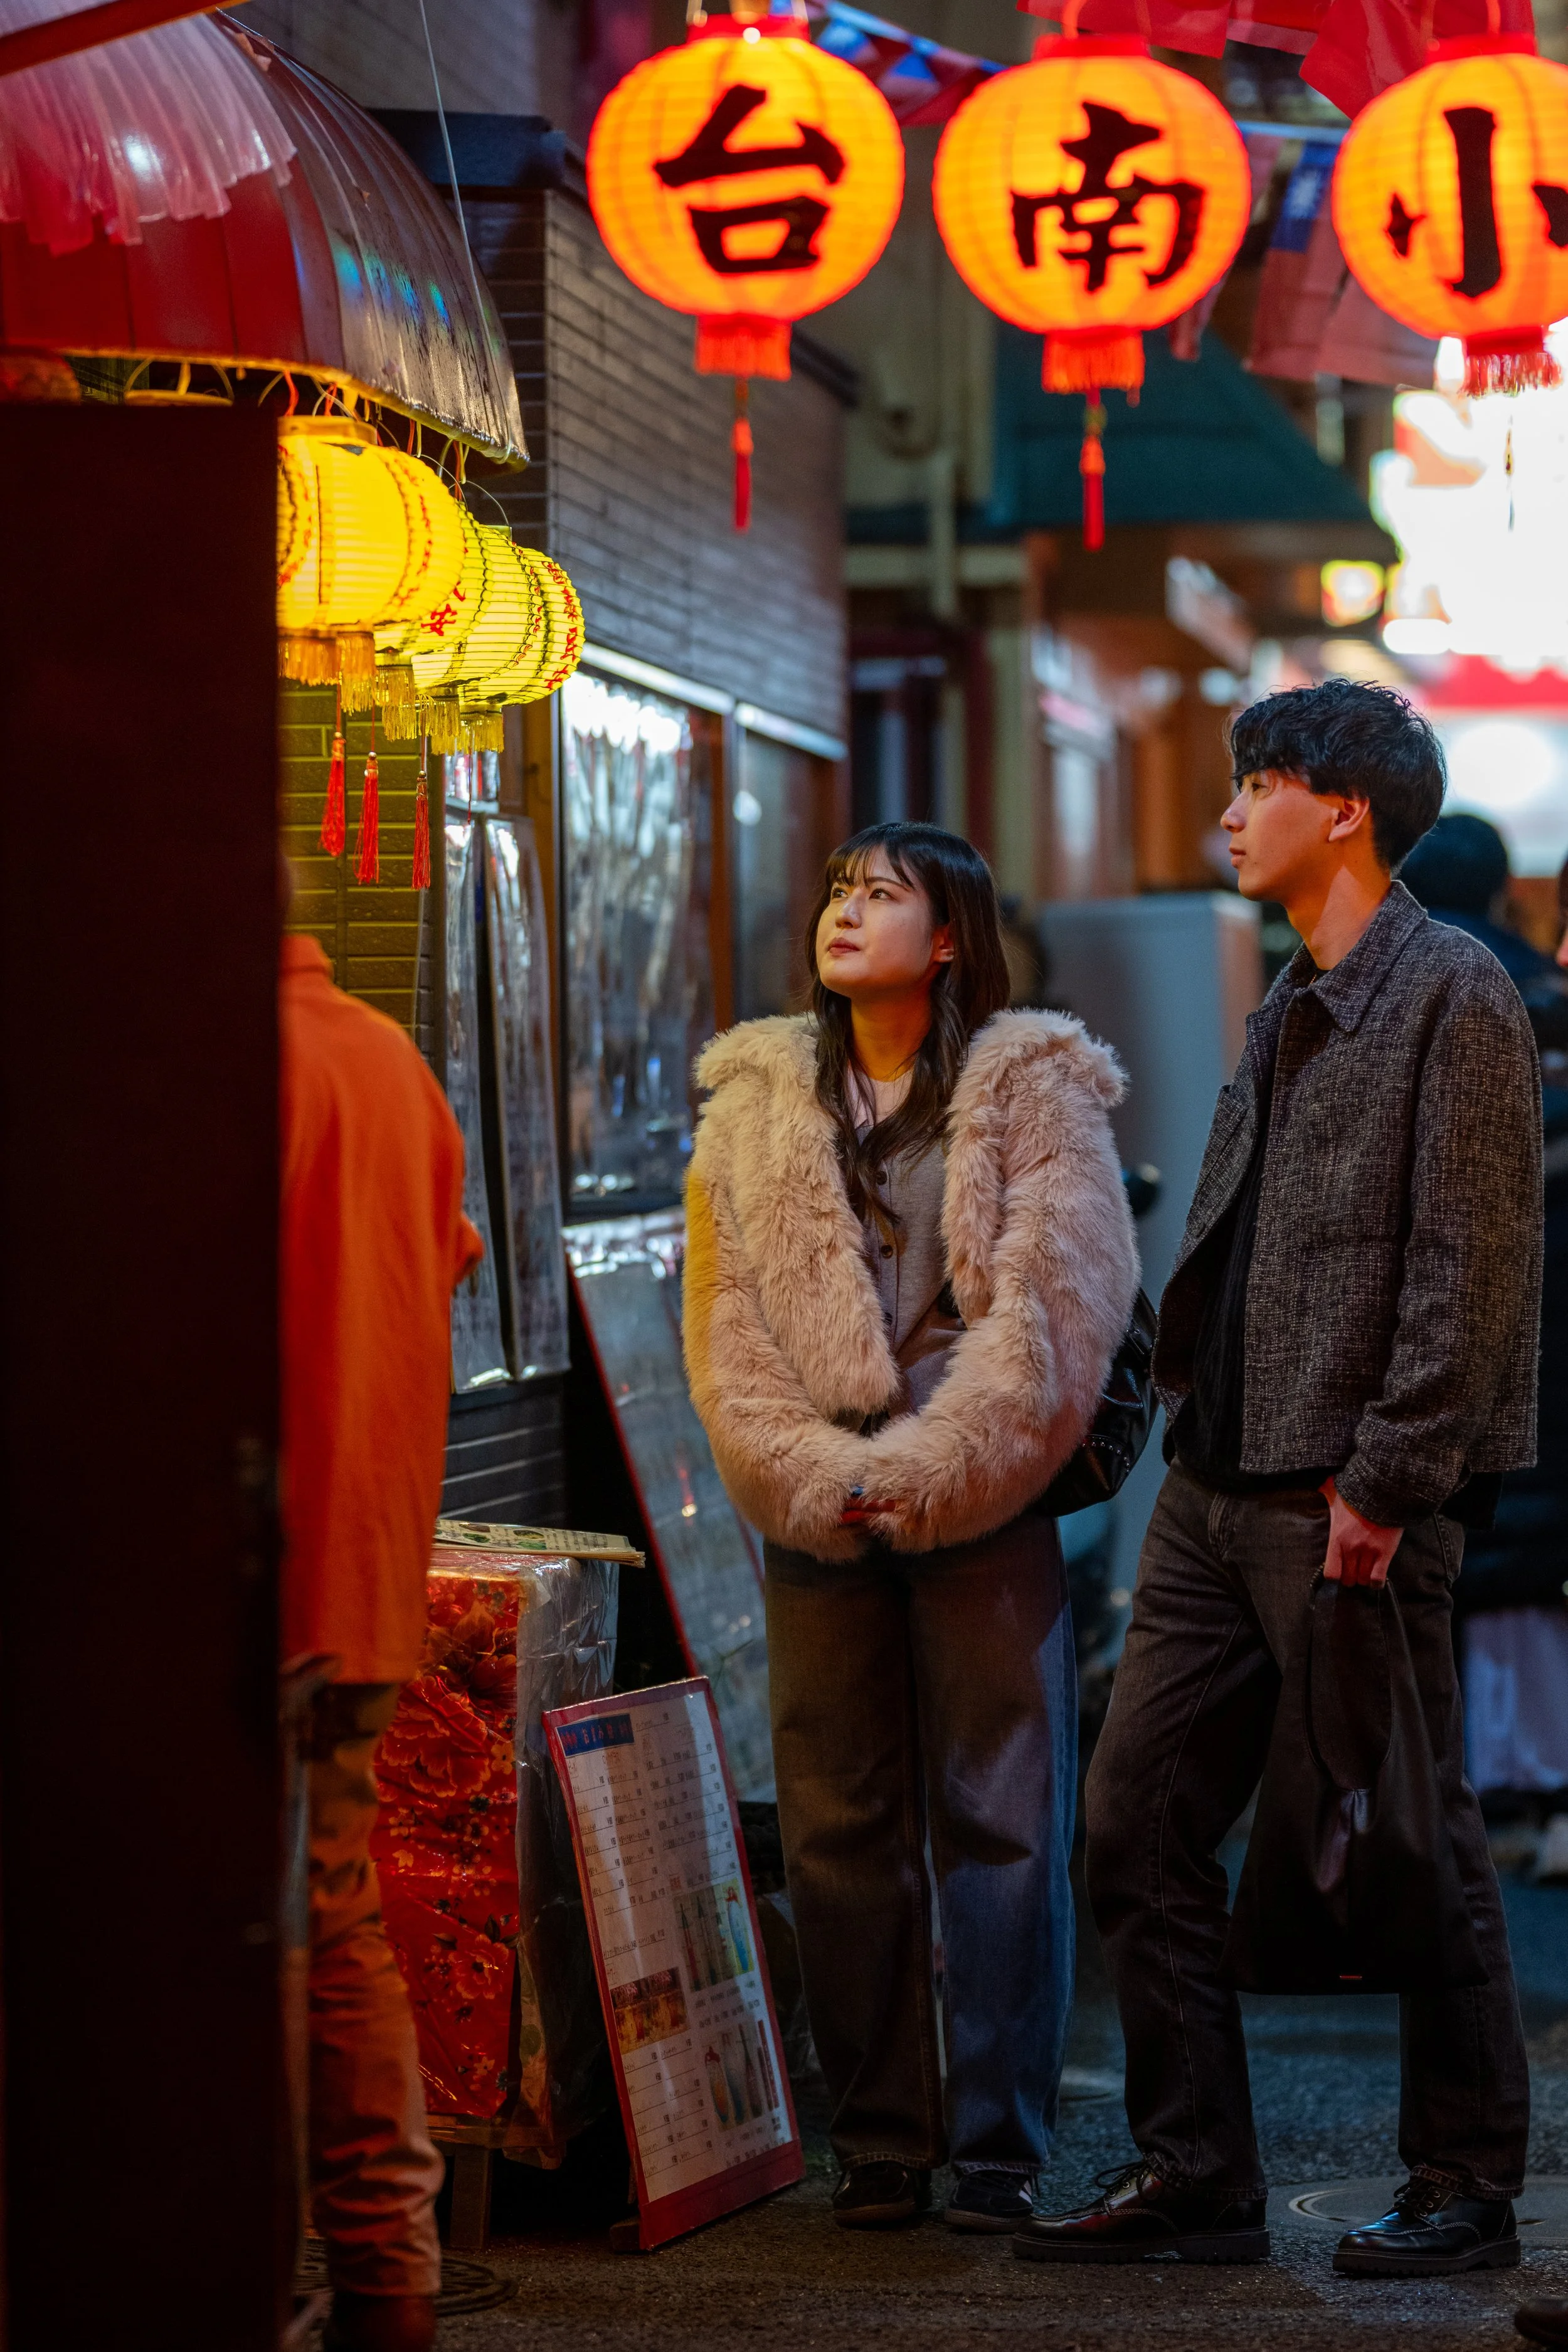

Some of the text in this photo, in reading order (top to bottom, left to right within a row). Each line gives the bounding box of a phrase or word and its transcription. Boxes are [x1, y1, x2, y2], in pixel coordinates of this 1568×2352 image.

[654, 84, 1568, 298] 台 南 小
